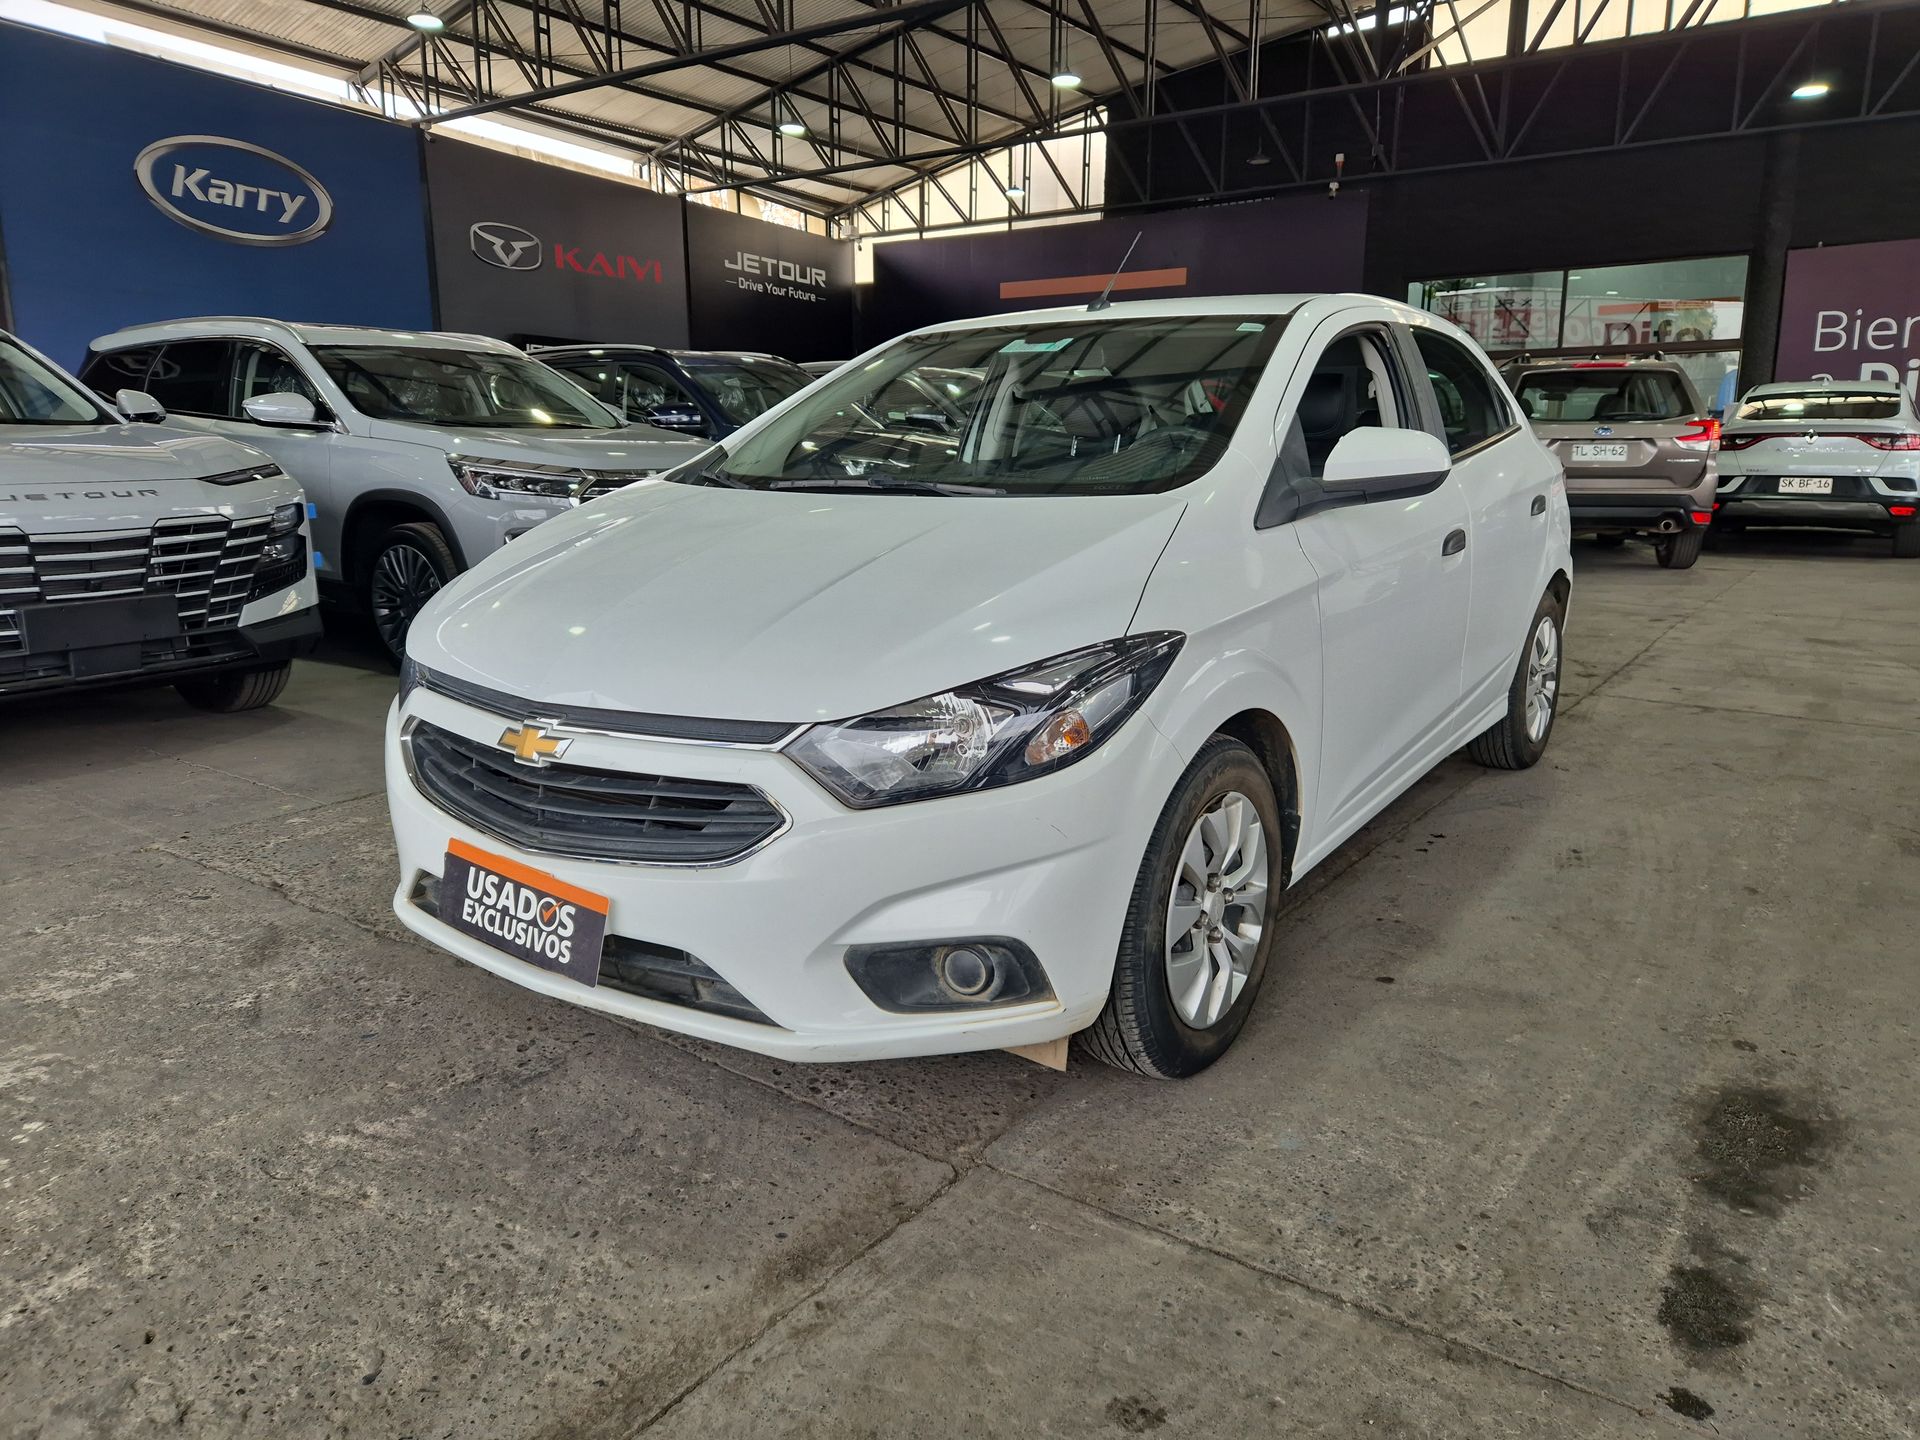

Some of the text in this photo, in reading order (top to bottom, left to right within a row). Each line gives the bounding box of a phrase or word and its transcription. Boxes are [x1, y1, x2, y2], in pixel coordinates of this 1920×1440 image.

[171, 163, 307, 224] Karry
[554, 243, 662, 284] KAIYI
[724, 251, 826, 288] JETOUR
[738, 277, 816, 302] Drive Your Future
[467, 866, 576, 937] USADOS
[462, 898, 572, 964] EXCLUSIVOS
